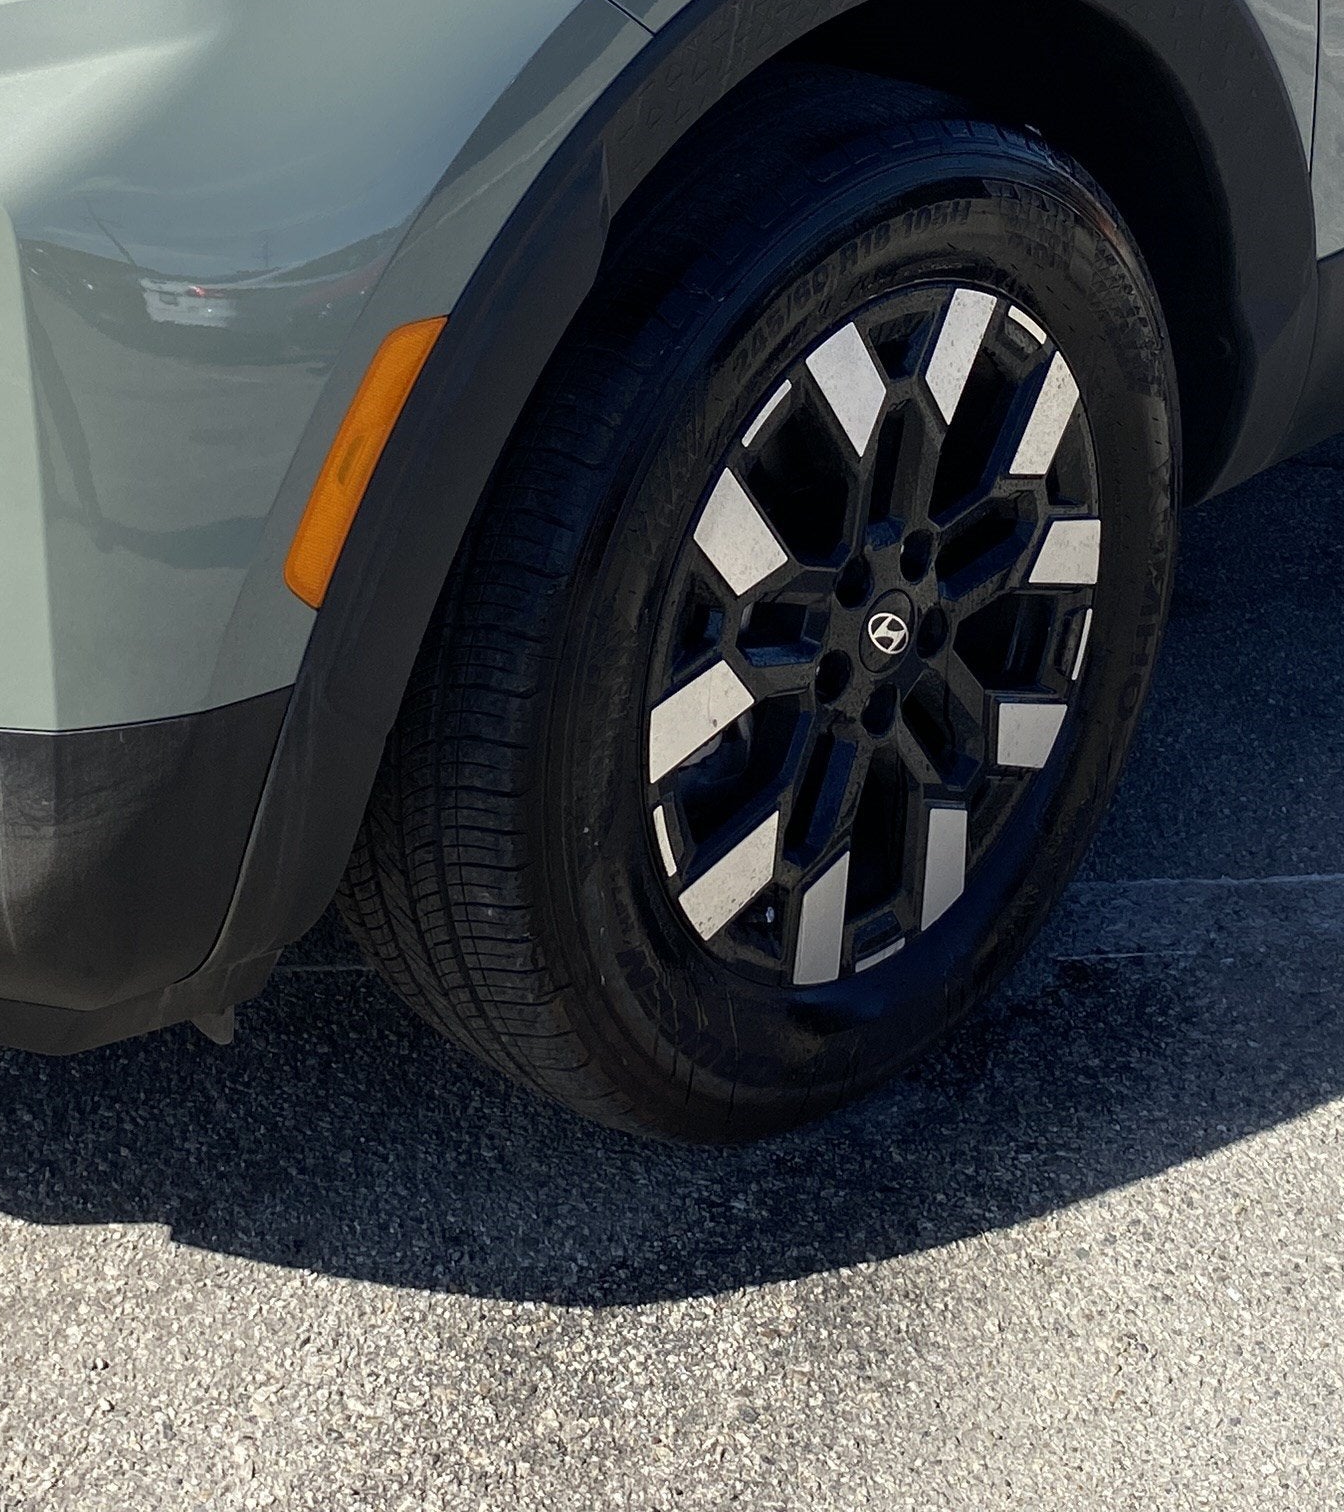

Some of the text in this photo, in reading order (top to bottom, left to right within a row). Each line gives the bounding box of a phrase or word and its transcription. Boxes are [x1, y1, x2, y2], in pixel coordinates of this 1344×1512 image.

[732, 198, 973, 374] 245/60 R18 105H
